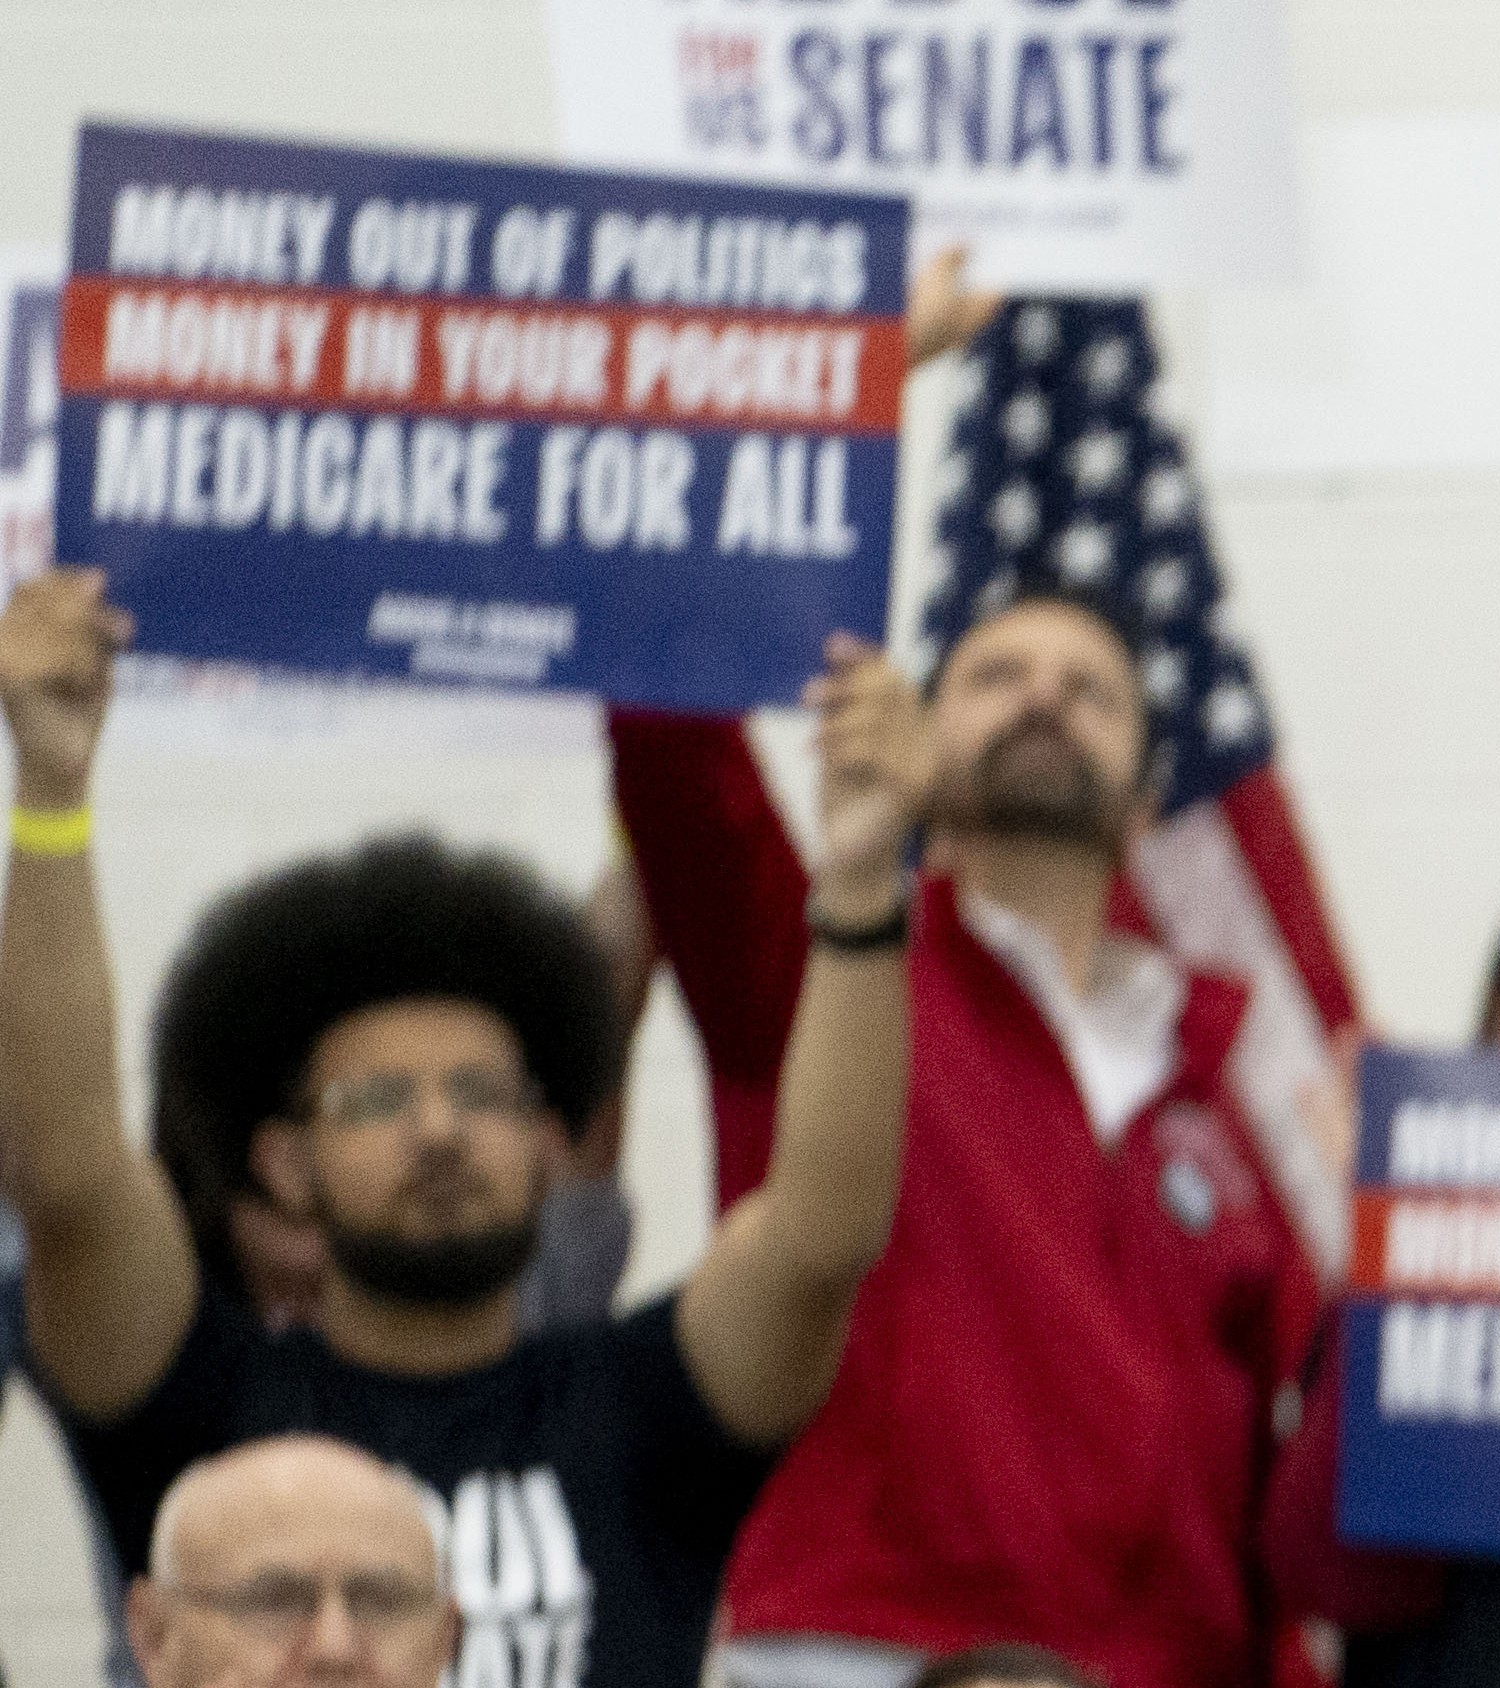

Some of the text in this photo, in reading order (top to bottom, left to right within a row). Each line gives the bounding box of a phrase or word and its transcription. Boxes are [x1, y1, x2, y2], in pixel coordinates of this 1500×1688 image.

[787, 27, 1188, 175] SENATE
[108, 184, 869, 313] MONEY OUT OF POLITICS
[103, 289, 331, 394] MONEY
[342, 301, 421, 400] IN
[438, 306, 612, 406] YOUR
[625, 319, 866, 418] POCKET
[92, 400, 859, 560] MEDICARE FOR ALL
